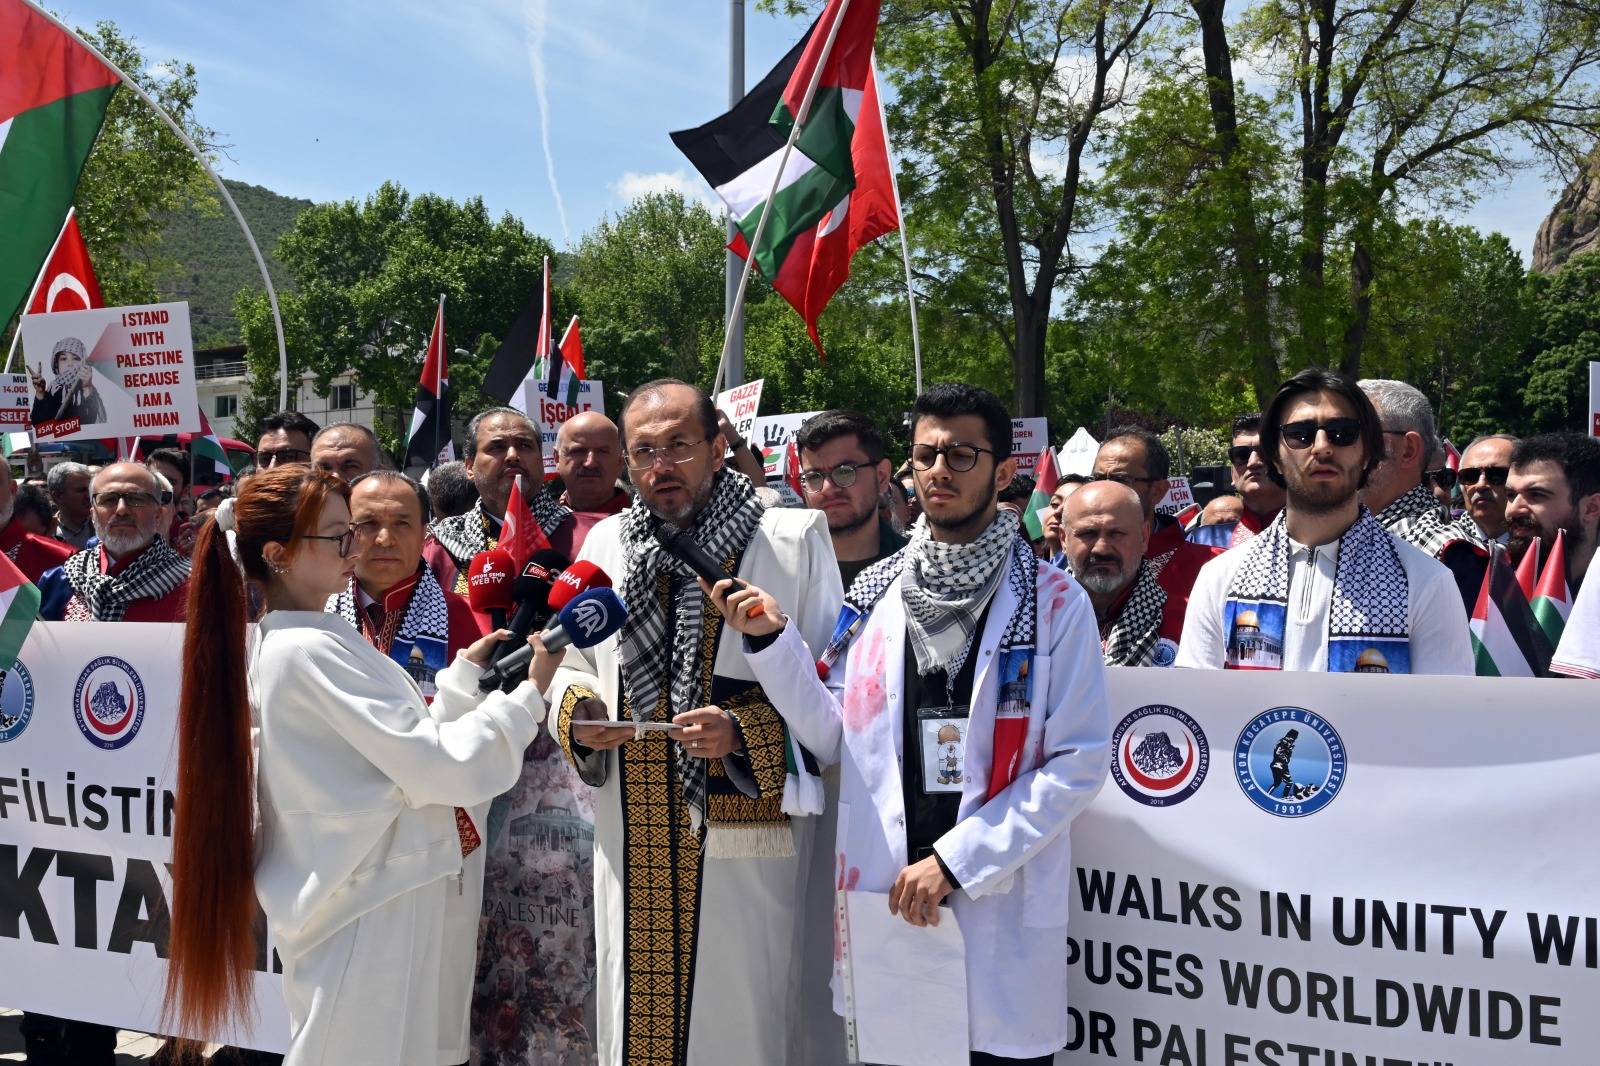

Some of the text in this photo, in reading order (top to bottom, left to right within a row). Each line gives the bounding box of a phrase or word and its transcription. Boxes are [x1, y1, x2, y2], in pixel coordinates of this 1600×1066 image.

[122, 310, 169, 327] I STAND
[130, 331, 165, 347] WITH
[116, 350, 183, 368] PALESTINE
[124, 371, 180, 388] BECAUSE
[136, 391, 173, 407] I AM A
[730, 383, 760, 403] GAZZE
[0, 411, 26, 421] SELF
[735, 399, 756, 420] İÇİN
[55, 419, 80, 434] STOP!
[133, 412, 180, 428] HUMAN
[471, 576, 503, 587] WEB TV
[1133, 707, 1161, 720] SAĞLIK
[1241, 711, 1296, 746] KOCATEPE
[1238, 752, 1256, 791] AFYON
[1274, 803, 1303, 814] 1992
[484, 899, 580, 928] PALESTINE
[1076, 866, 1243, 932] WALKS
[1259, 890, 1311, 942] IN
[1332, 896, 1508, 959] UNITY
[1219, 958, 1562, 1047] WORLDWIDE
